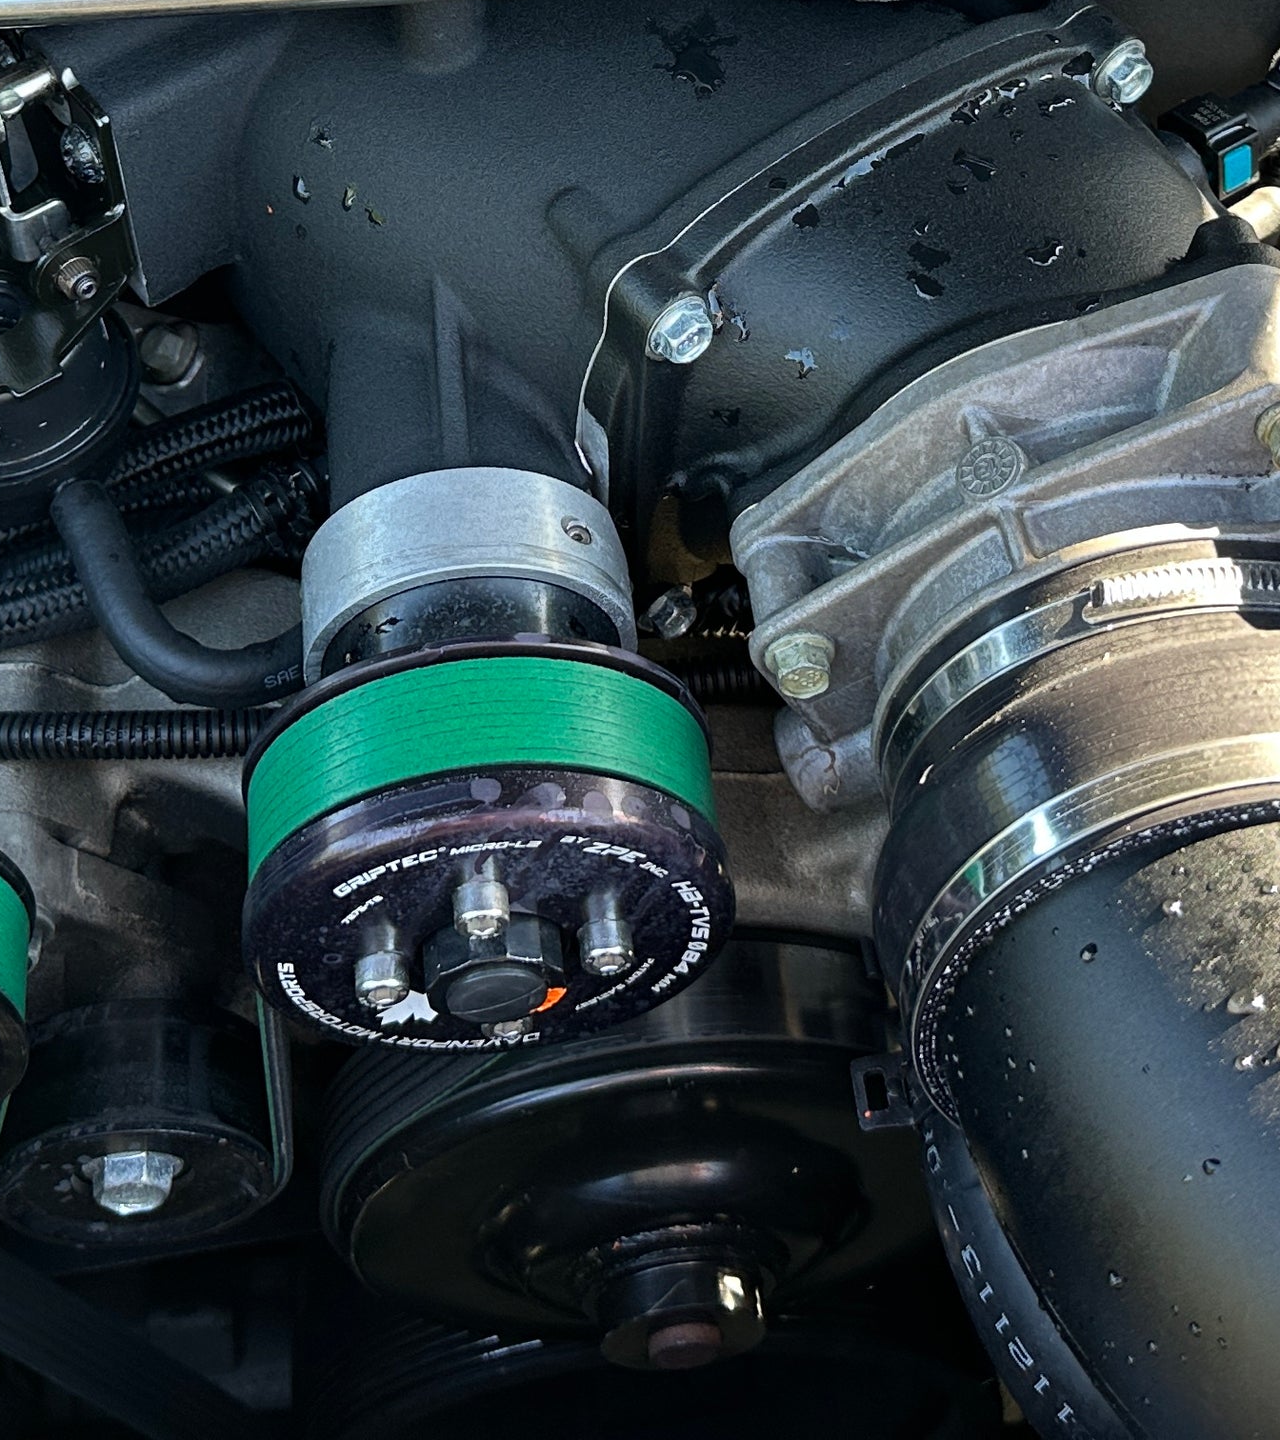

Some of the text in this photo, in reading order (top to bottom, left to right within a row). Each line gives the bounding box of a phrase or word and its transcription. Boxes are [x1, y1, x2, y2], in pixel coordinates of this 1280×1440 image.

[583, 841, 646, 864] ZPE
[650, 974, 677, 994] MM
[277, 962, 541, 1054] DAVENPORT MOTORSPORTS
